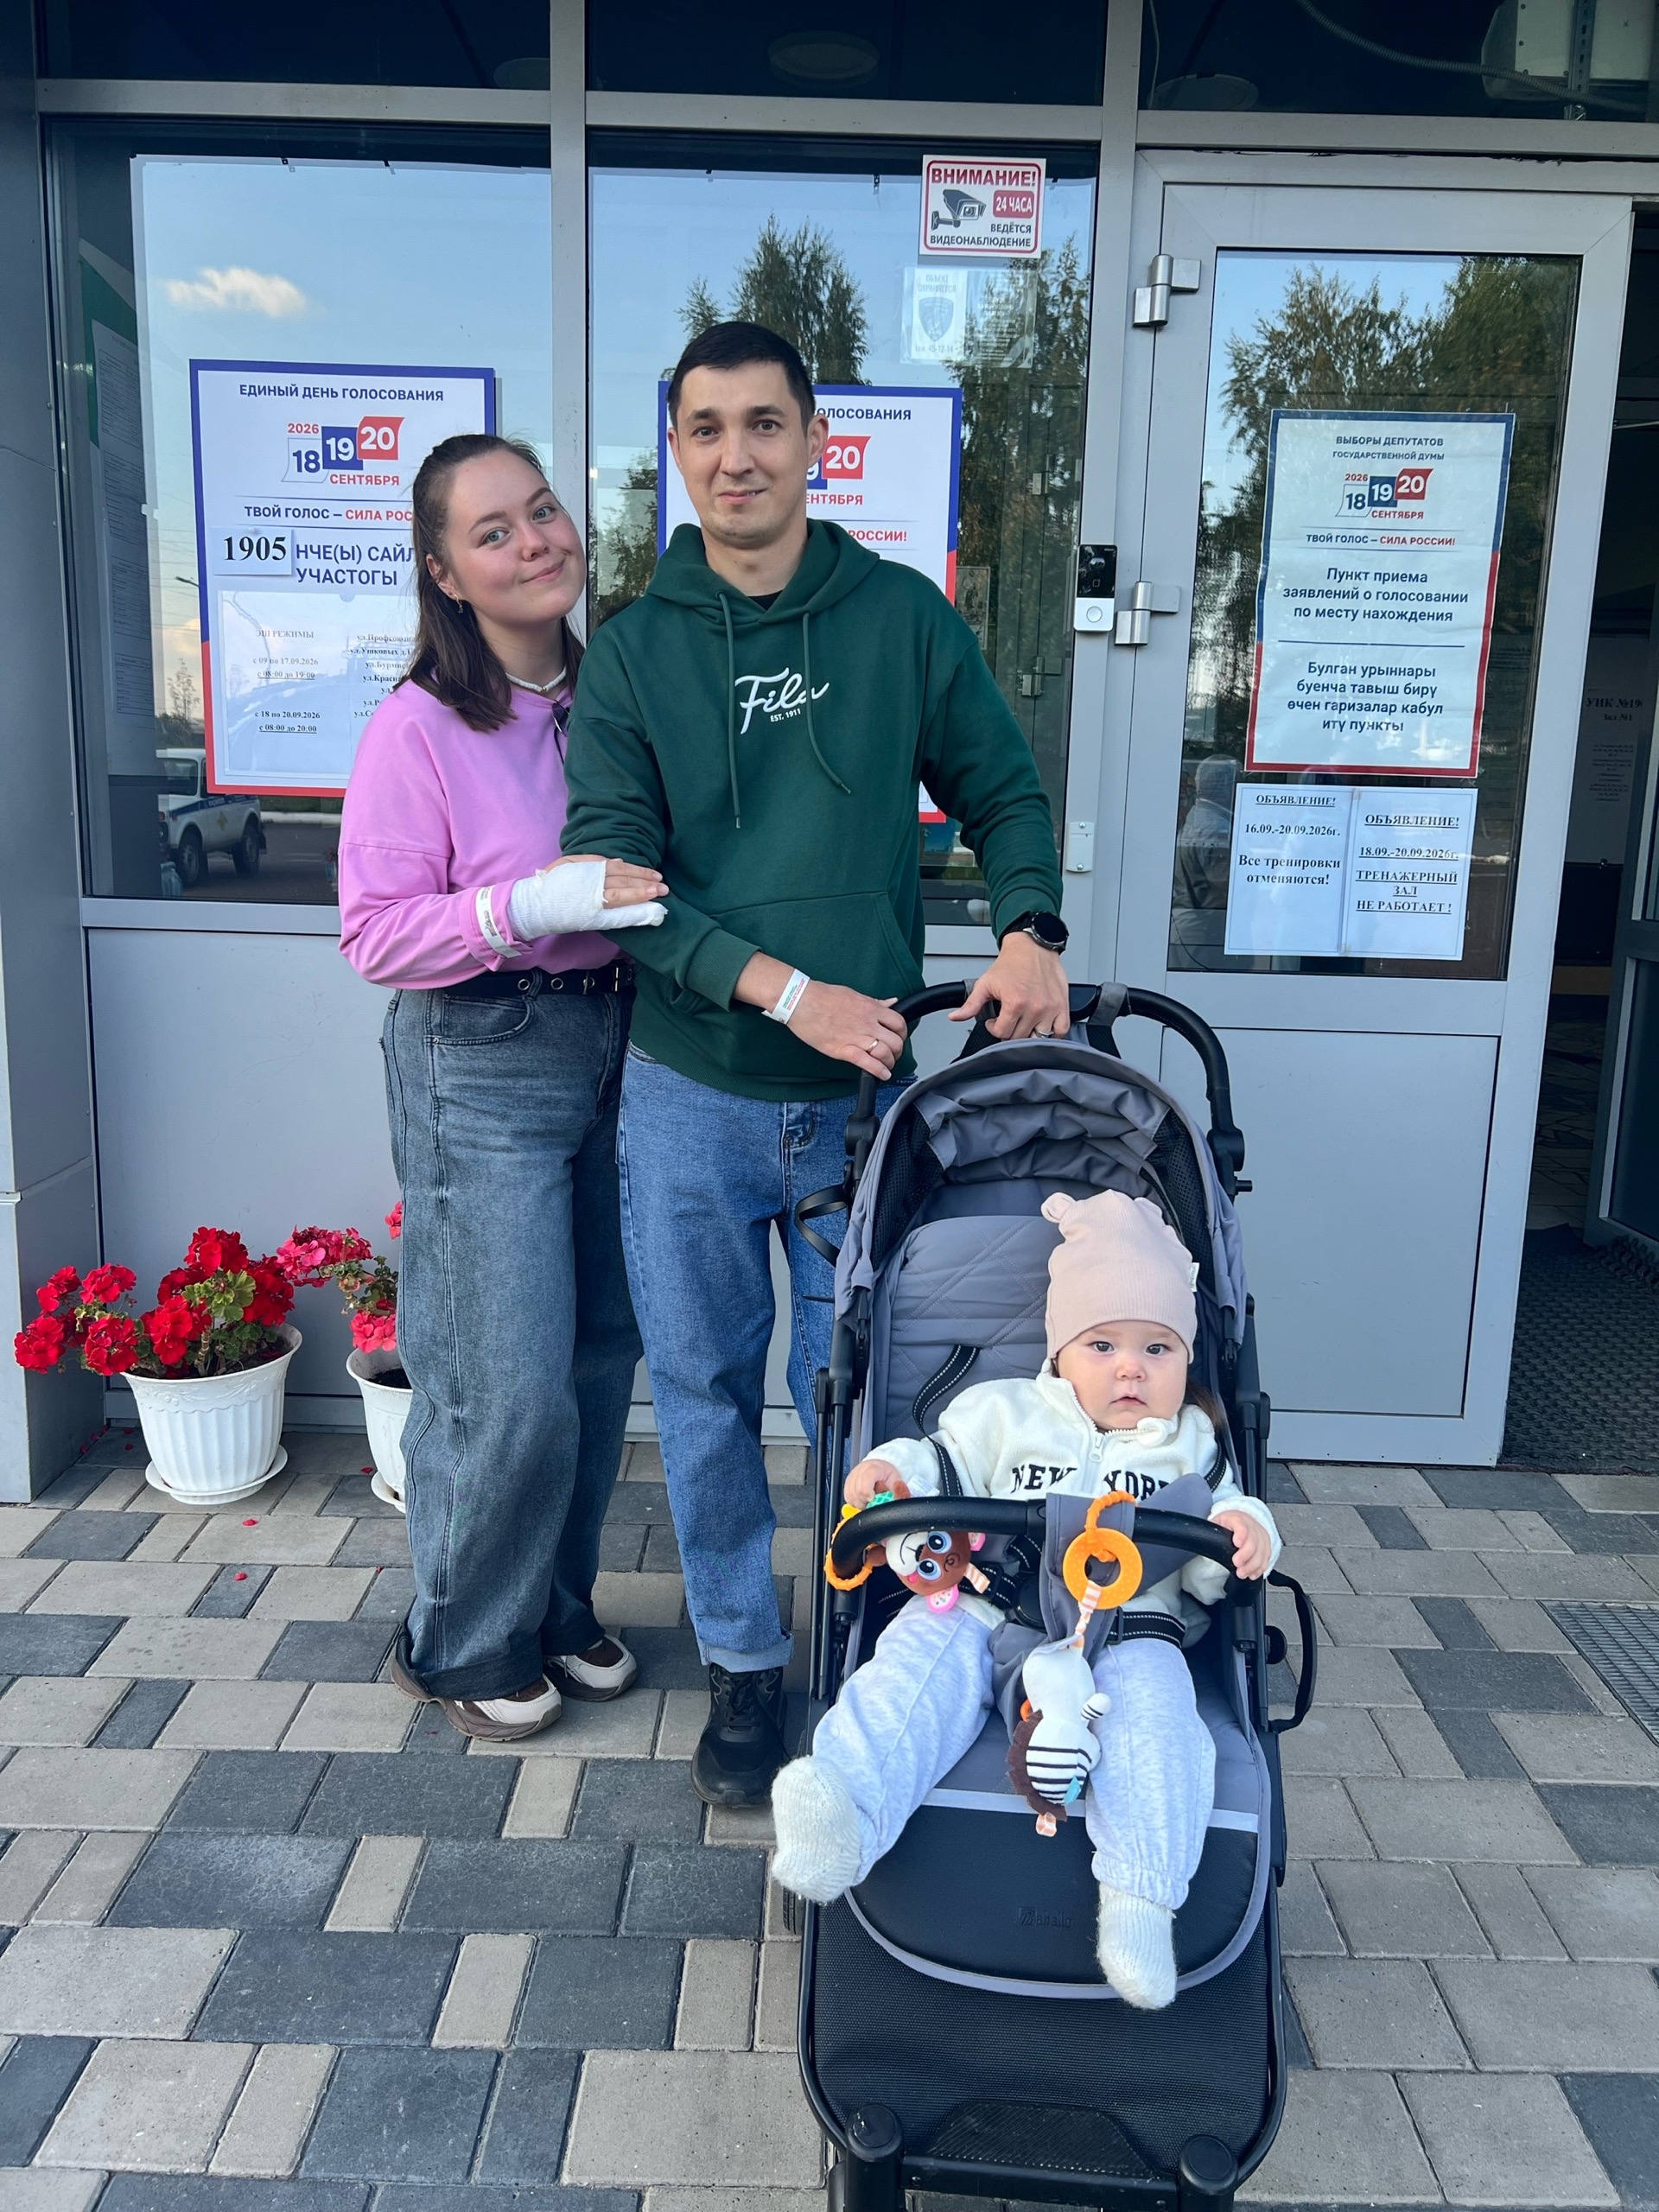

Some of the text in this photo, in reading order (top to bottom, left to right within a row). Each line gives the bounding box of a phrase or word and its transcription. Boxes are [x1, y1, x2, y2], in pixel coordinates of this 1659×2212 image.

[931, 168, 1036, 186] ВНИМАНИЕ!
[995, 196, 1033, 213] 24 ЧАСА
[990, 222, 1032, 234] ВЕДЁТСЯ
[930, 235, 1031, 248] ВИДЕОНАБЛЮДЕНИЕ
[239, 384, 443, 401] ЕДИНЫЙ ДЕНЬ ГОЛОСОВАНИЯ
[817, 408, 912, 420] ОЛОСОВАНИЯ
[288, 423, 319, 435] 2026
[1336, 435, 1444, 448] ВЫБОРЫ ДЕПУТАТОВ
[292, 426, 395, 474] 18 19 20
[1332, 450, 1445, 461] ГОСУДАРСТВЕННОЙ ДУМЫ
[825, 445, 861, 470] 20
[329, 474, 400, 486] СЕНТЯБРЯ
[1344, 474, 1369, 482] 2026
[1345, 475, 1425, 511] 18 19 20
[245, 505, 281, 518] ТВОЙ
[285, 507, 330, 518] ГОЛОС
[346, 510, 382, 520] СИЛА
[1371, 511, 1424, 519] СЕНТЯБРЯ
[1306, 532, 1335, 543] ТВОЙ
[1337, 534, 1369, 544] ГОЛОС
[1380, 536, 1407, 545] СИЛА
[1410, 537, 1456, 546] РОССИИ!
[223, 536, 286, 561] 1905
[296, 544, 362, 564] НЧЕ(Ы)
[296, 568, 397, 585] УЧАСТОГЫ
[1326, 568, 1427, 585] Пункт приема
[1282, 586, 1468, 603] заявлений о голосовании
[1294, 607, 1453, 623] по месту нахождения
[1307, 662, 1436, 679] Булган урыннары
[1296, 679, 1438, 698] буенча тавыш бирү
[1287, 699, 1444, 715] өчен гаризалар кабул
[1616, 697, 1643, 709] №19
[770, 708, 801, 722] EST. 1911
[1322, 719, 1404, 734] итү пункты
[1255, 794, 1336, 806] ОБЪЯВЛЕНИЕ!
[1365, 813, 1459, 827] ОБЪЯВЛЕНИЕ!
[1244, 823, 1340, 836] 16.09.-20.09.2026г.
[1359, 846, 1459, 860] 18.09.-20.09.2026г.
[1238, 854, 1341, 870] Все тренировки
[1246, 873, 1330, 886] отменяются!
[1356, 869, 1459, 883] ТРЕНАЖЕРНЫЙ
[1393, 885, 1418, 896] ЗАЛ
[1356, 899, 1375, 911] НЕ
[1377, 900, 1443, 913] РАБОТАЕТ
[1011, 1464, 1169, 1501] NEW YOR
